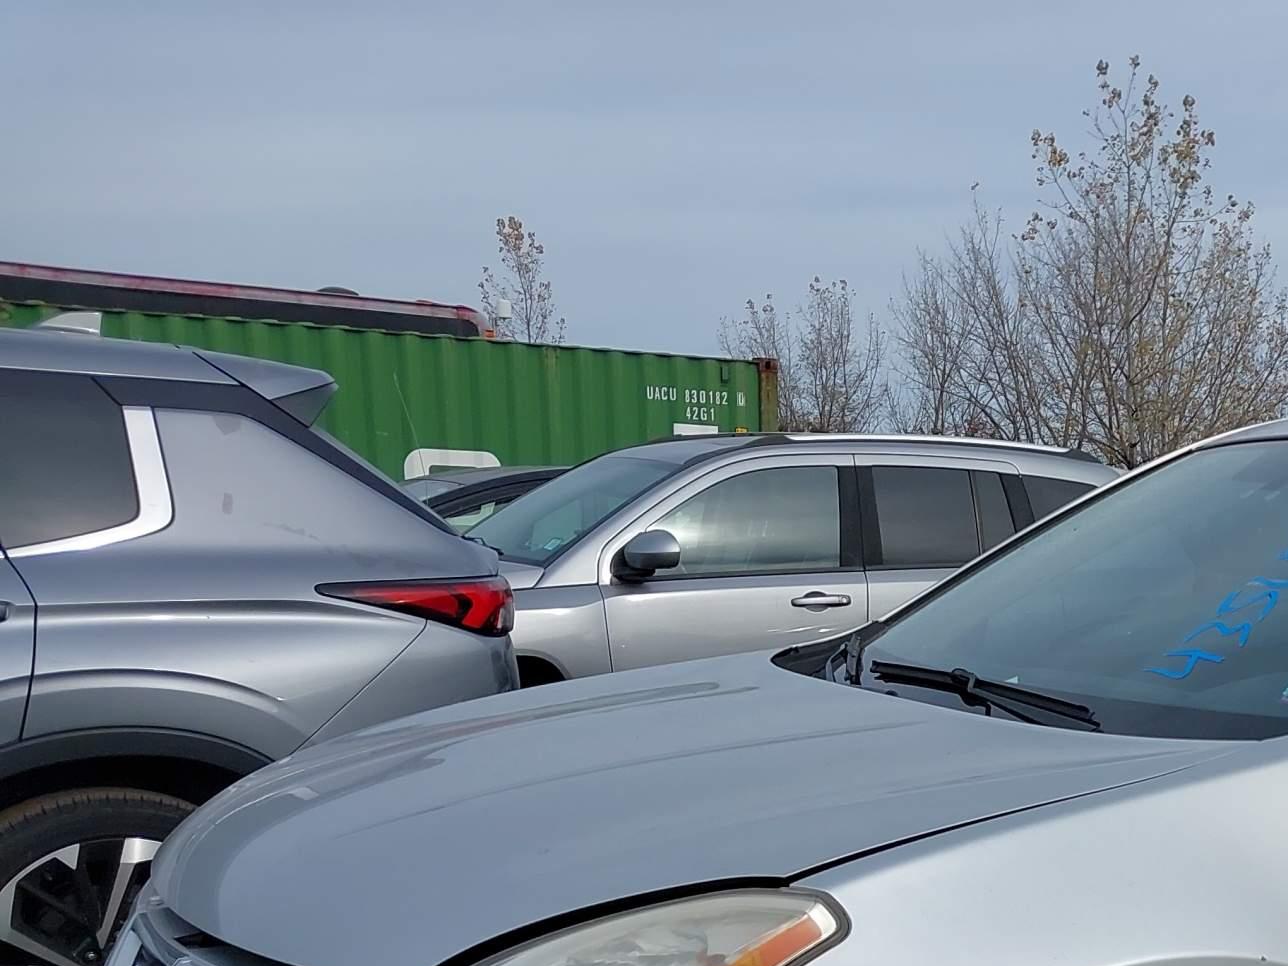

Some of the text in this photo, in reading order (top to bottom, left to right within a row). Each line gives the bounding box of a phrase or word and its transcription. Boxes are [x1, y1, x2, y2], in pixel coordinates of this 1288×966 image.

[646, 386, 677, 401] UACU
[684, 389, 728, 405] 830182
[685, 406, 715, 421] 42G1
